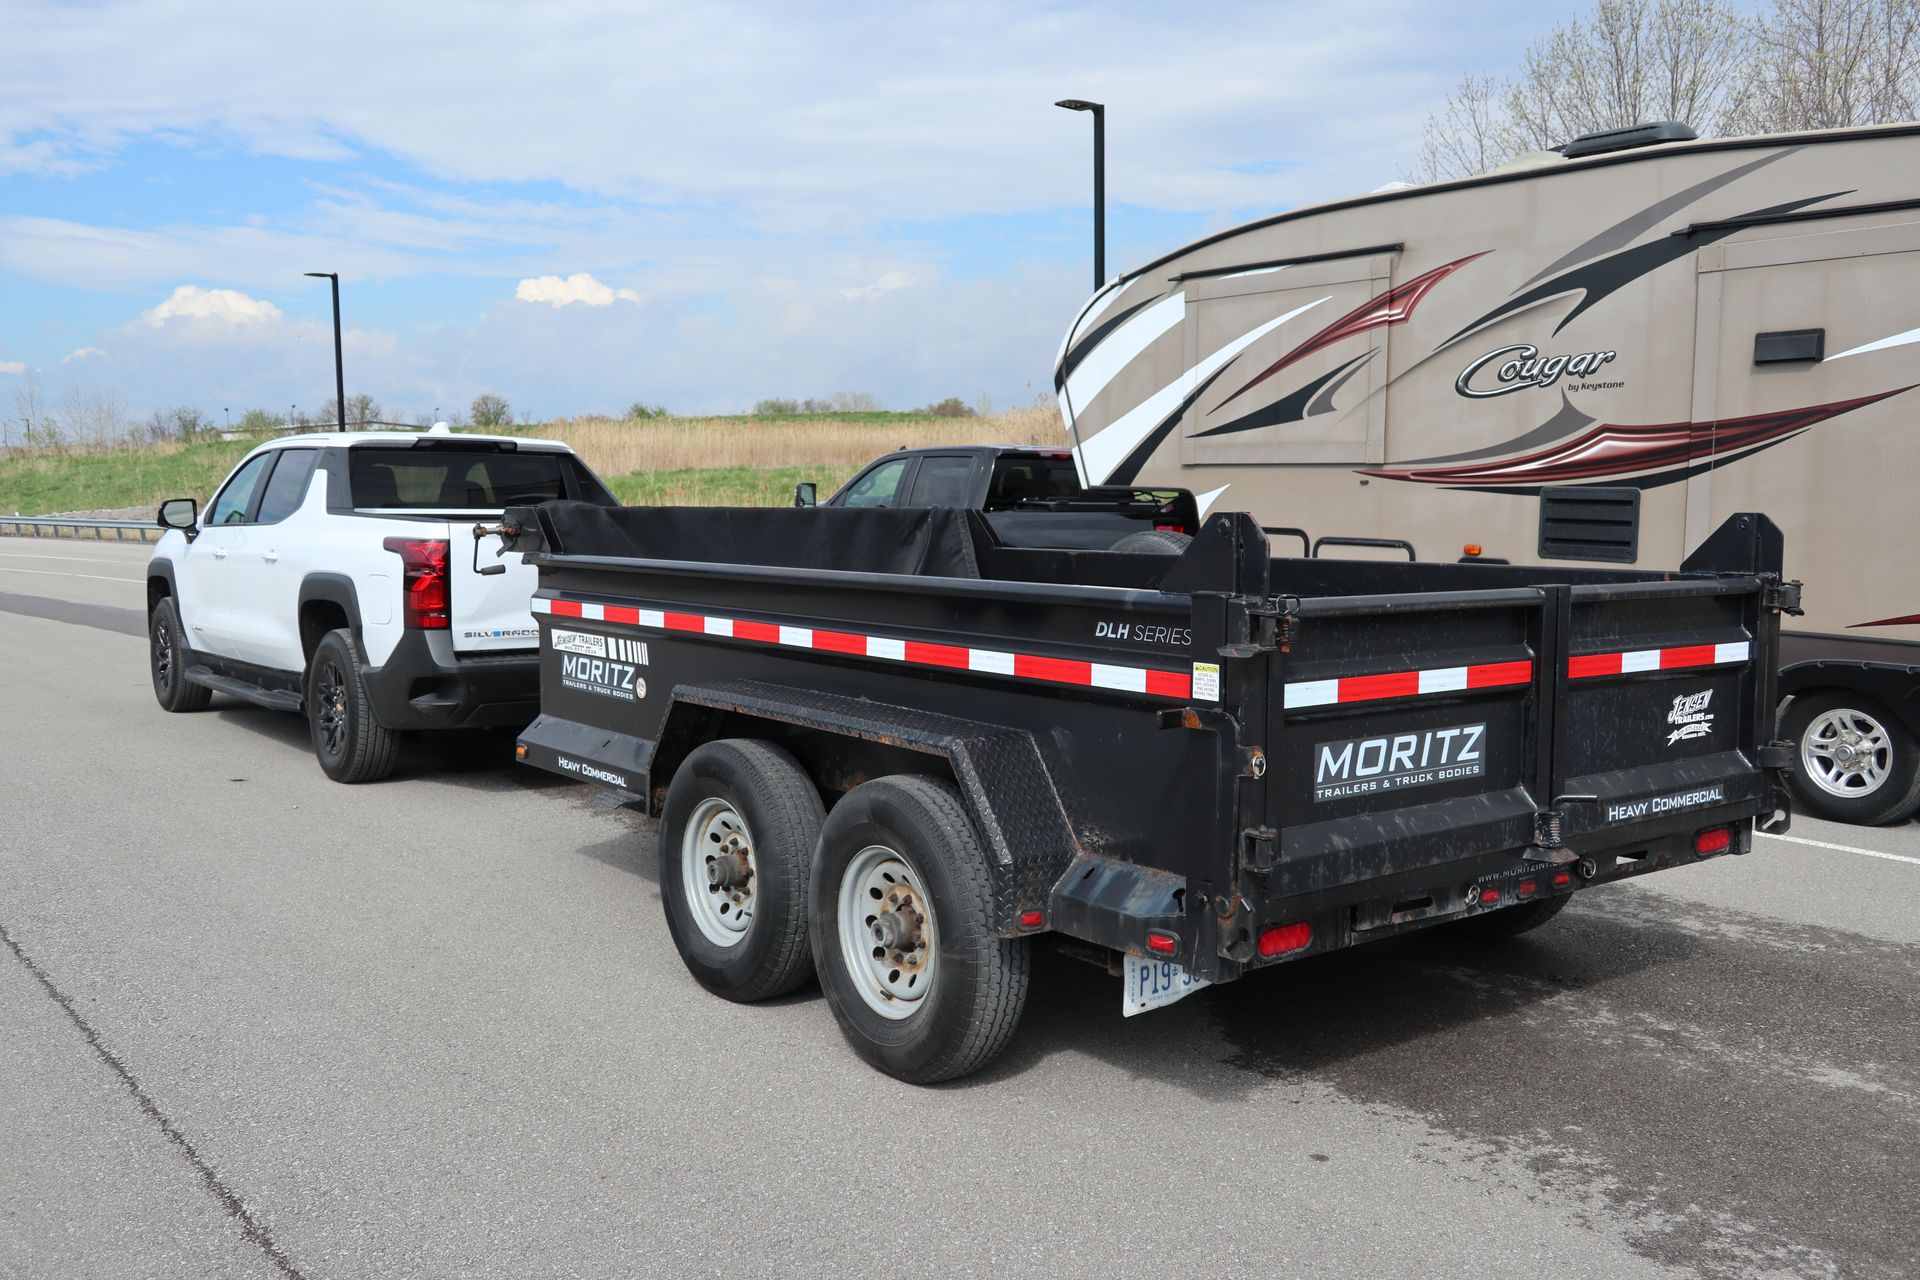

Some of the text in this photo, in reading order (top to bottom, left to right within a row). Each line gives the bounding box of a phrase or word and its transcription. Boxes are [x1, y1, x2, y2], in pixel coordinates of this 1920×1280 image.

[1455, 344, 1616, 398] Cougar
[1568, 380, 1624, 392] by Keystone
[554, 634, 578, 648] JENSEN
[578, 635, 602, 647] TRAILERS
[1096, 622, 1192, 646] DLH SERIES
[562, 655, 634, 690] MORITZ
[563, 680, 587, 690] TRAILERS
[594, 686, 611, 695] TRUCK
[612, 690, 634, 700] BODIES
[1668, 688, 1714, 724] JENSEN
[1317, 726, 1484, 782] MORITZ
[558, 756, 626, 786] HEAVY COMMERCIAL
[1316, 766, 1480, 798] TRAILERS & TRUCK BODIES
[1608, 788, 1722, 822] HEAVY COMMERCIAL
